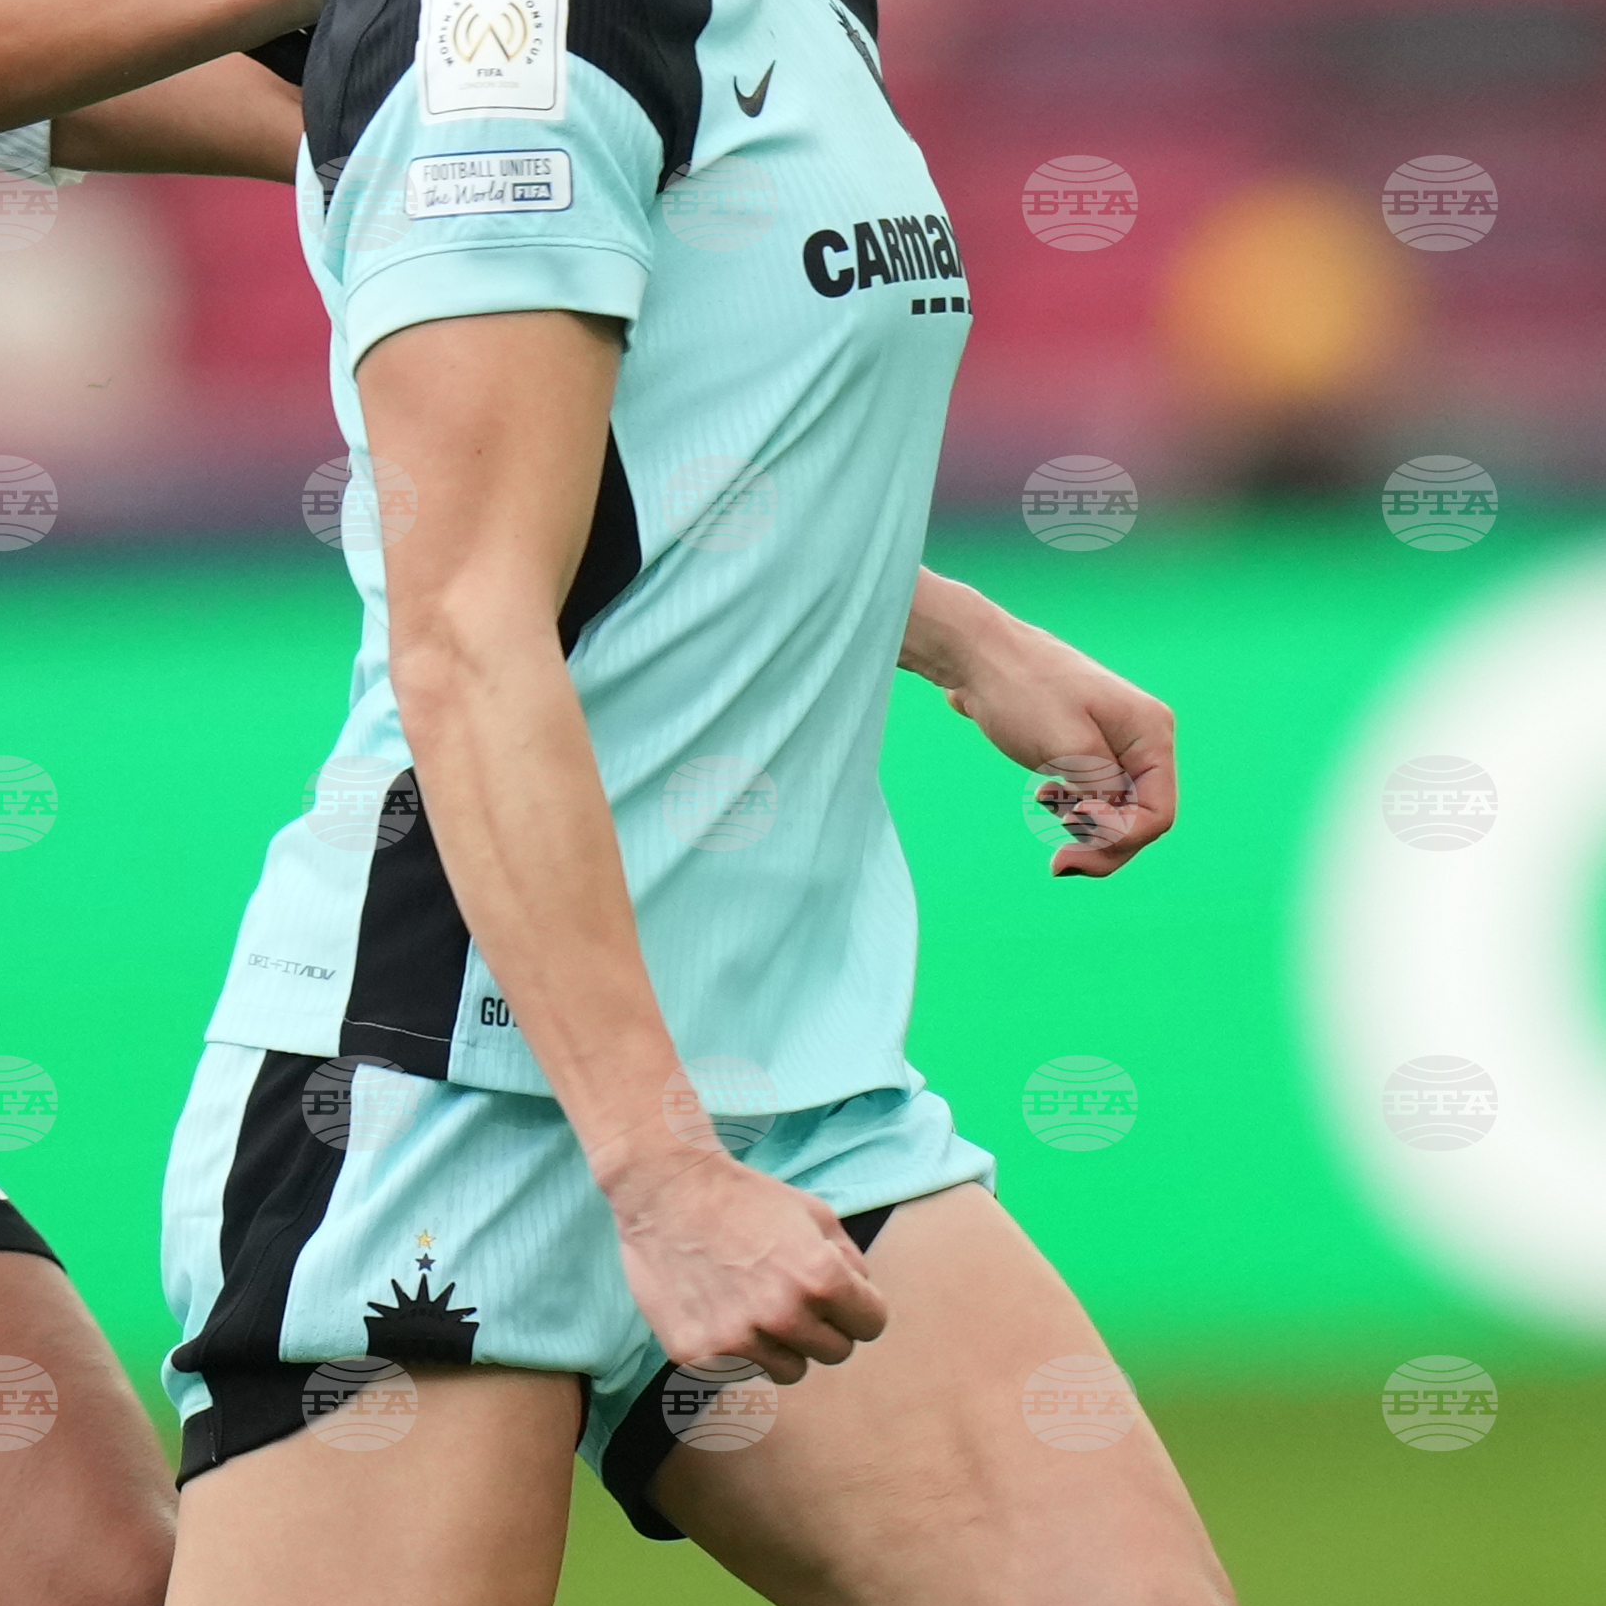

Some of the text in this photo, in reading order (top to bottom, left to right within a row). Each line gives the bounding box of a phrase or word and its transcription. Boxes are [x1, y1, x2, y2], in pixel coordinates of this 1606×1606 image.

[437, 0, 462, 68] WOMEN'S
[525, 37, 543, 65] CUP
[476, 68, 504, 78] FIFA
[423, 157, 553, 182] FOOTBALL UNITES
[423, 181, 551, 209] the World FIFA
[481, 996, 519, 1028] GO
